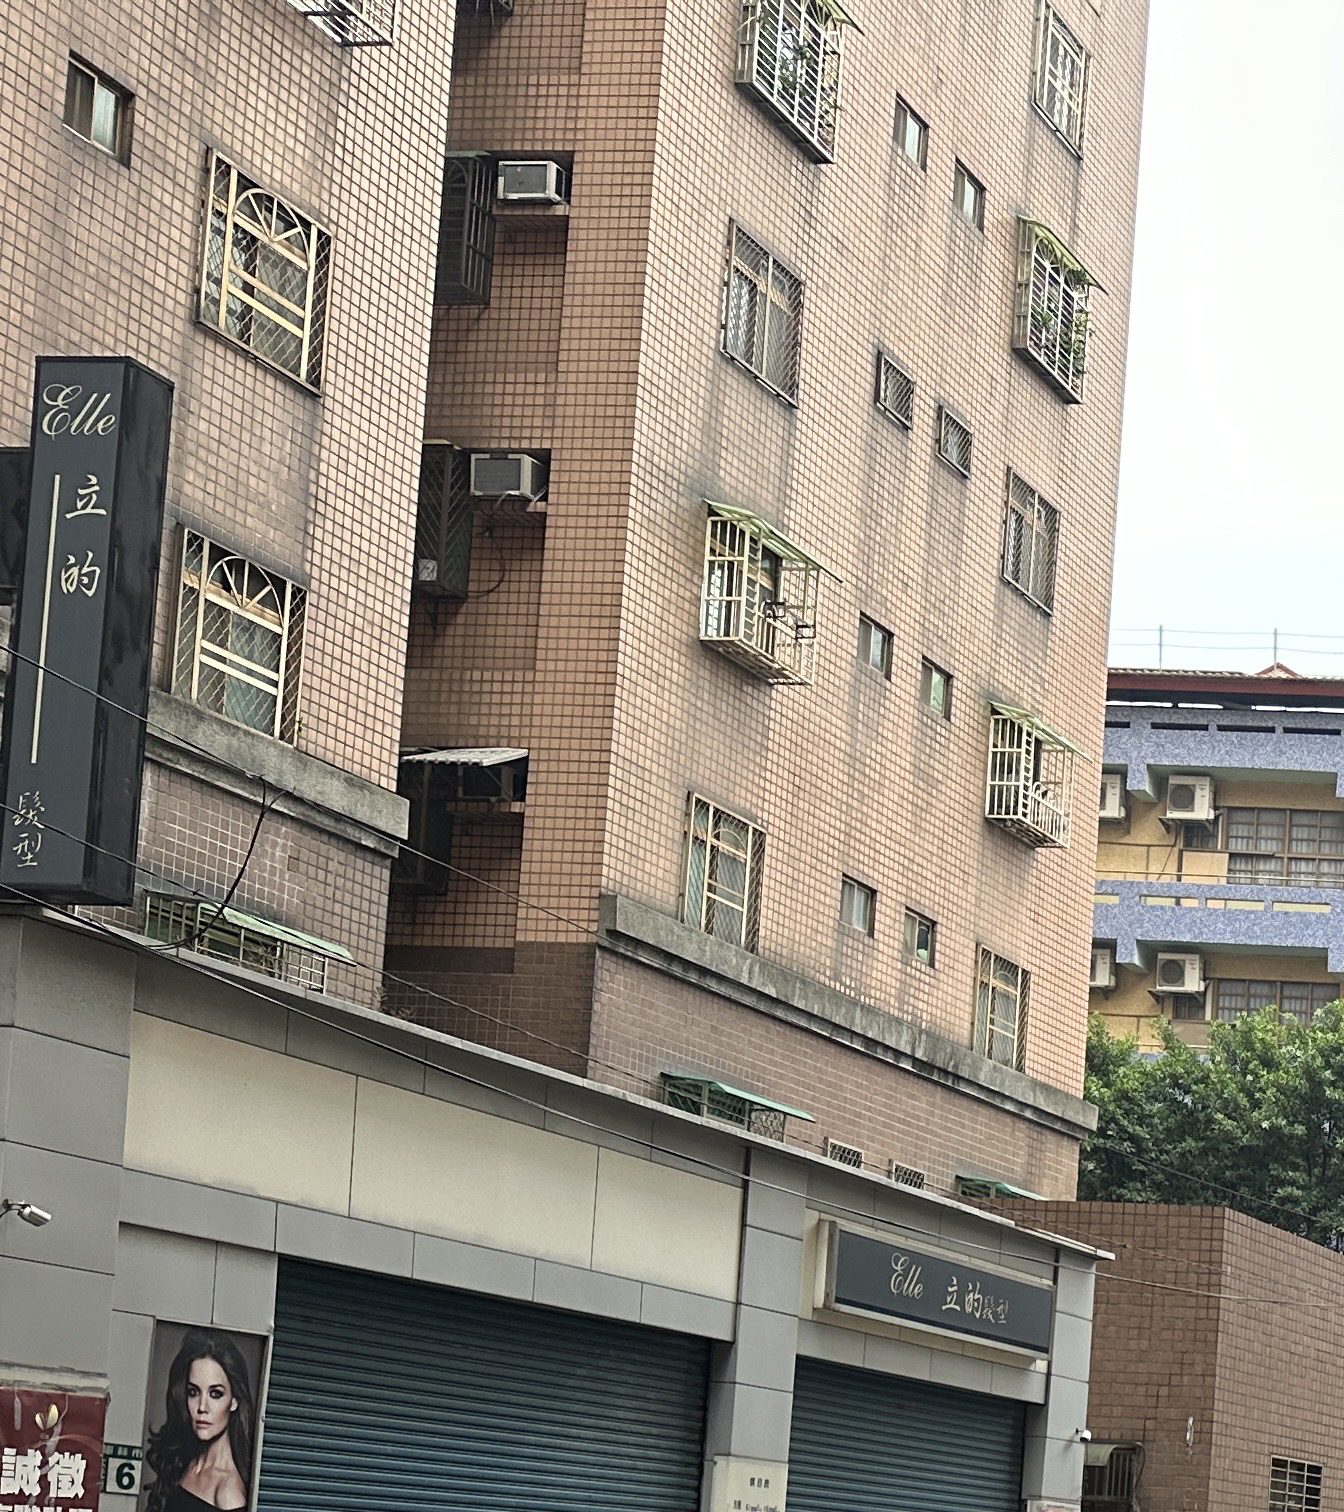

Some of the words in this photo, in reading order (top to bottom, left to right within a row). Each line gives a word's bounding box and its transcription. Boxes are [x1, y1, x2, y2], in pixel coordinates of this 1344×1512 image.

[41, 384, 117, 438] Elle
[59, 475, 107, 598] 立的
[11, 790, 46, 868] 髮型
[890, 1252, 924, 1299] Elle
[0, 1447, 88, 1499] 誠徵
[116, 1462, 135, 1490] 6
